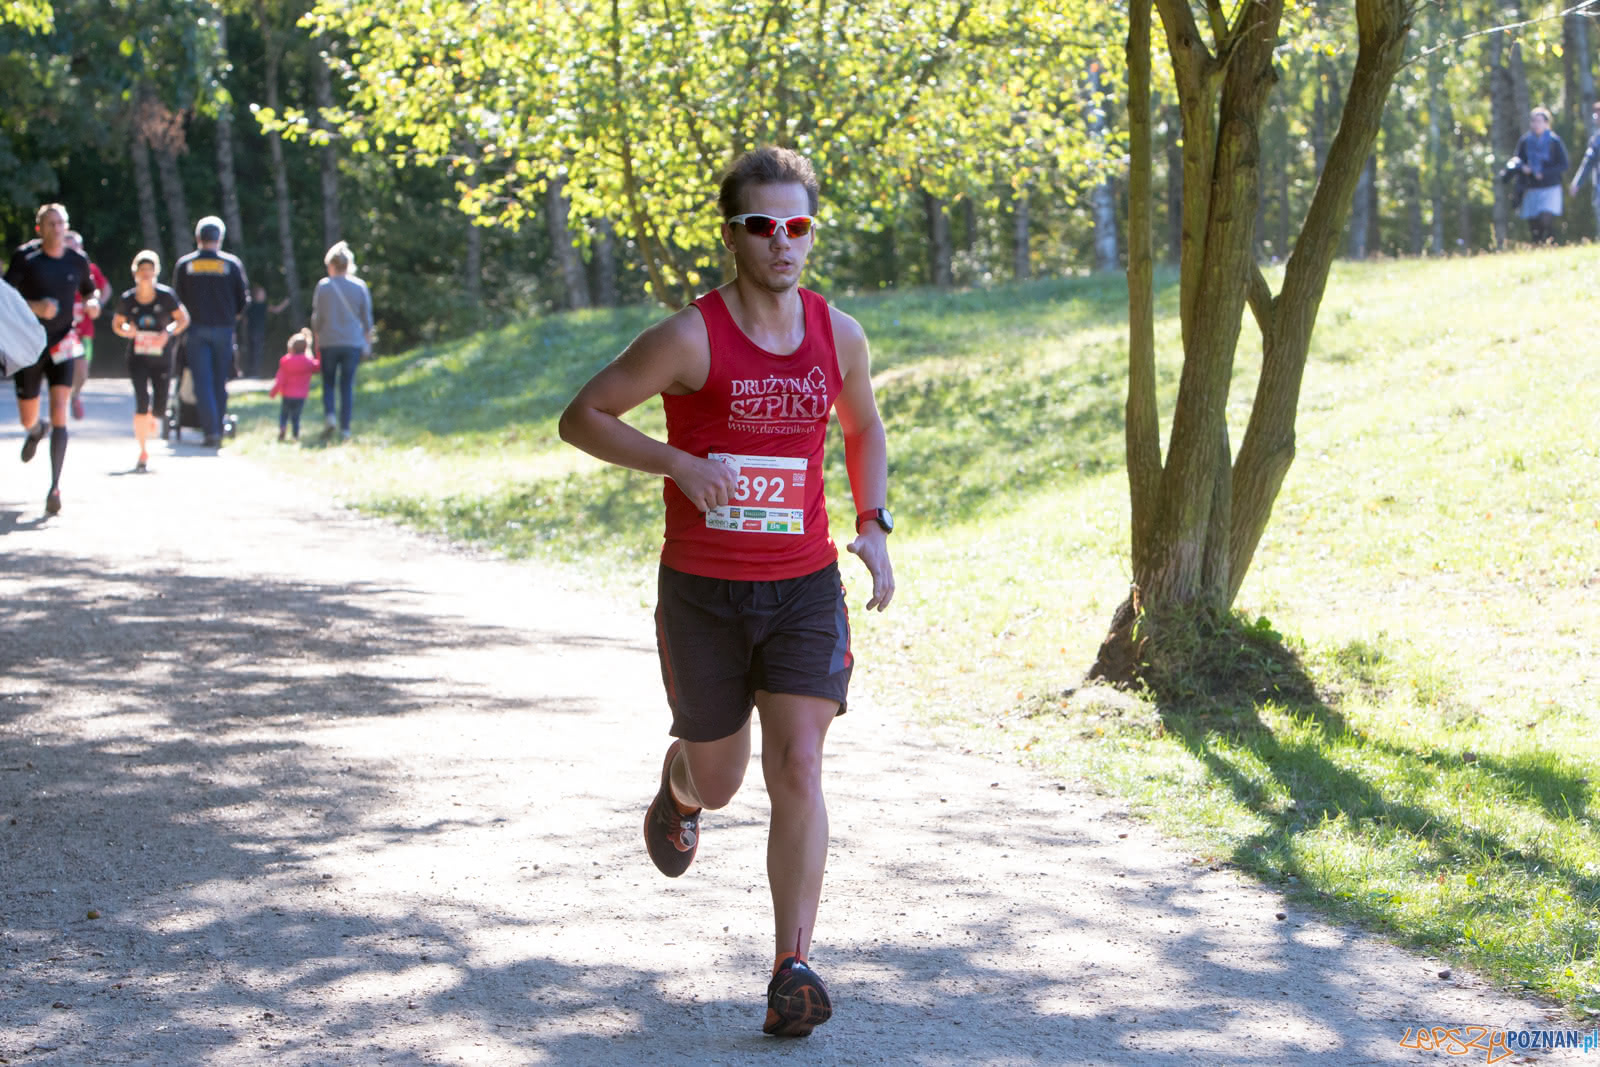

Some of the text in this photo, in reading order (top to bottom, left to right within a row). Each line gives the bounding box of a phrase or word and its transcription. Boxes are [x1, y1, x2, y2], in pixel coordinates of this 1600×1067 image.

[731, 375, 812, 396] DRUŻYNA
[730, 394, 827, 419] SZPIKU
[735, 475, 785, 502] 392
